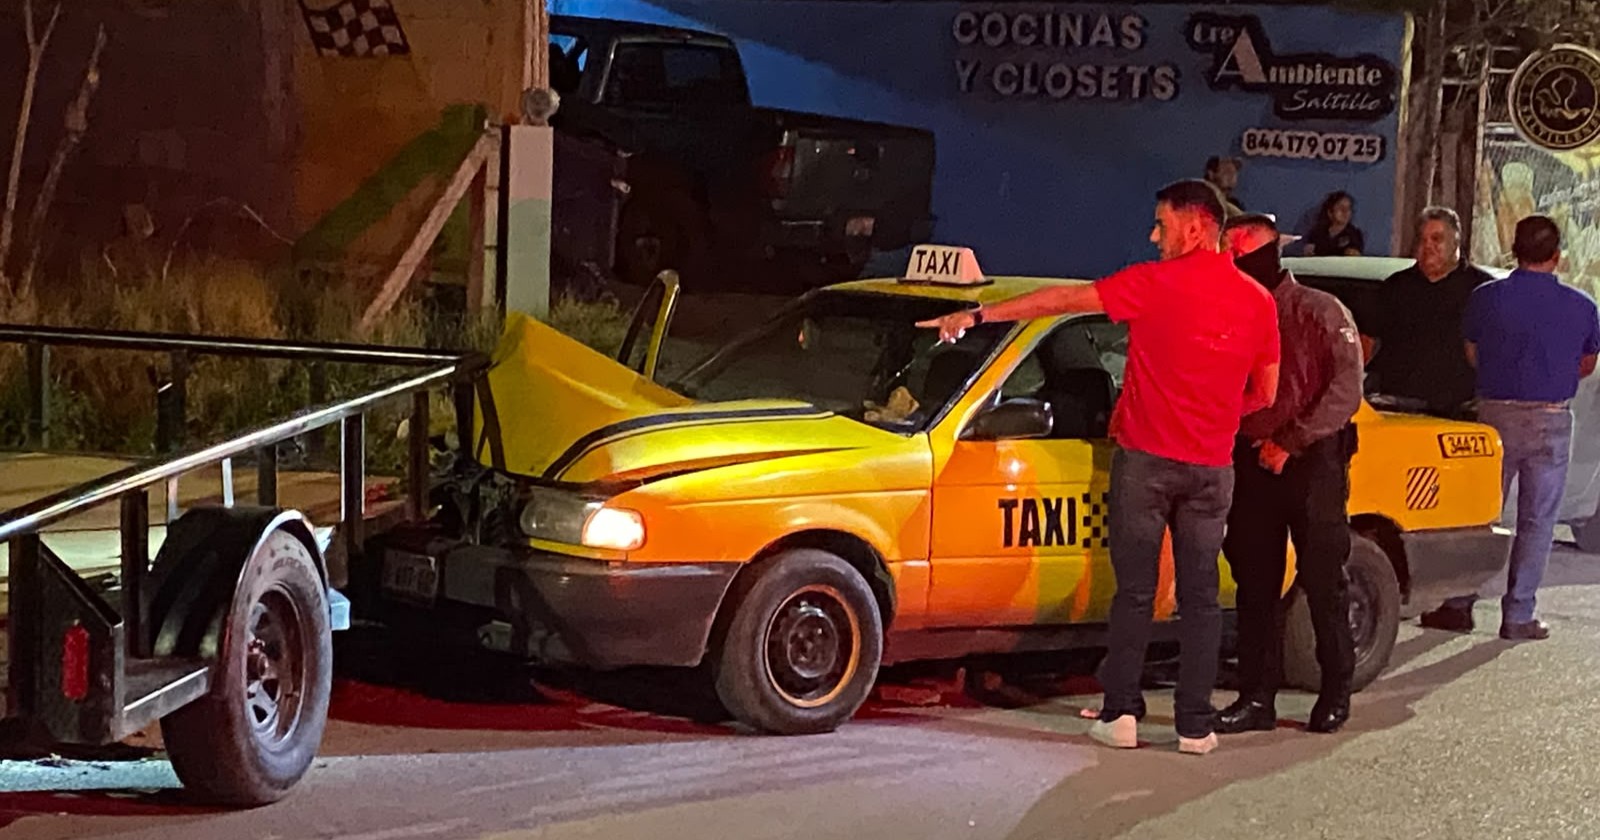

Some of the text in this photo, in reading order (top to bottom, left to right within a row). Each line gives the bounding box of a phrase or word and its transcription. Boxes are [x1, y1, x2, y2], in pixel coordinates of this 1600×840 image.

[953, 12, 1144, 49] COCINAS
[954, 60, 1177, 100] Y CLOSETS
[1281, 89, 1381, 112] Saltillo
[1353, 138, 1377, 156] 25
[916, 249, 961, 276] TAXI
[998, 497, 1077, 548] TAXI
